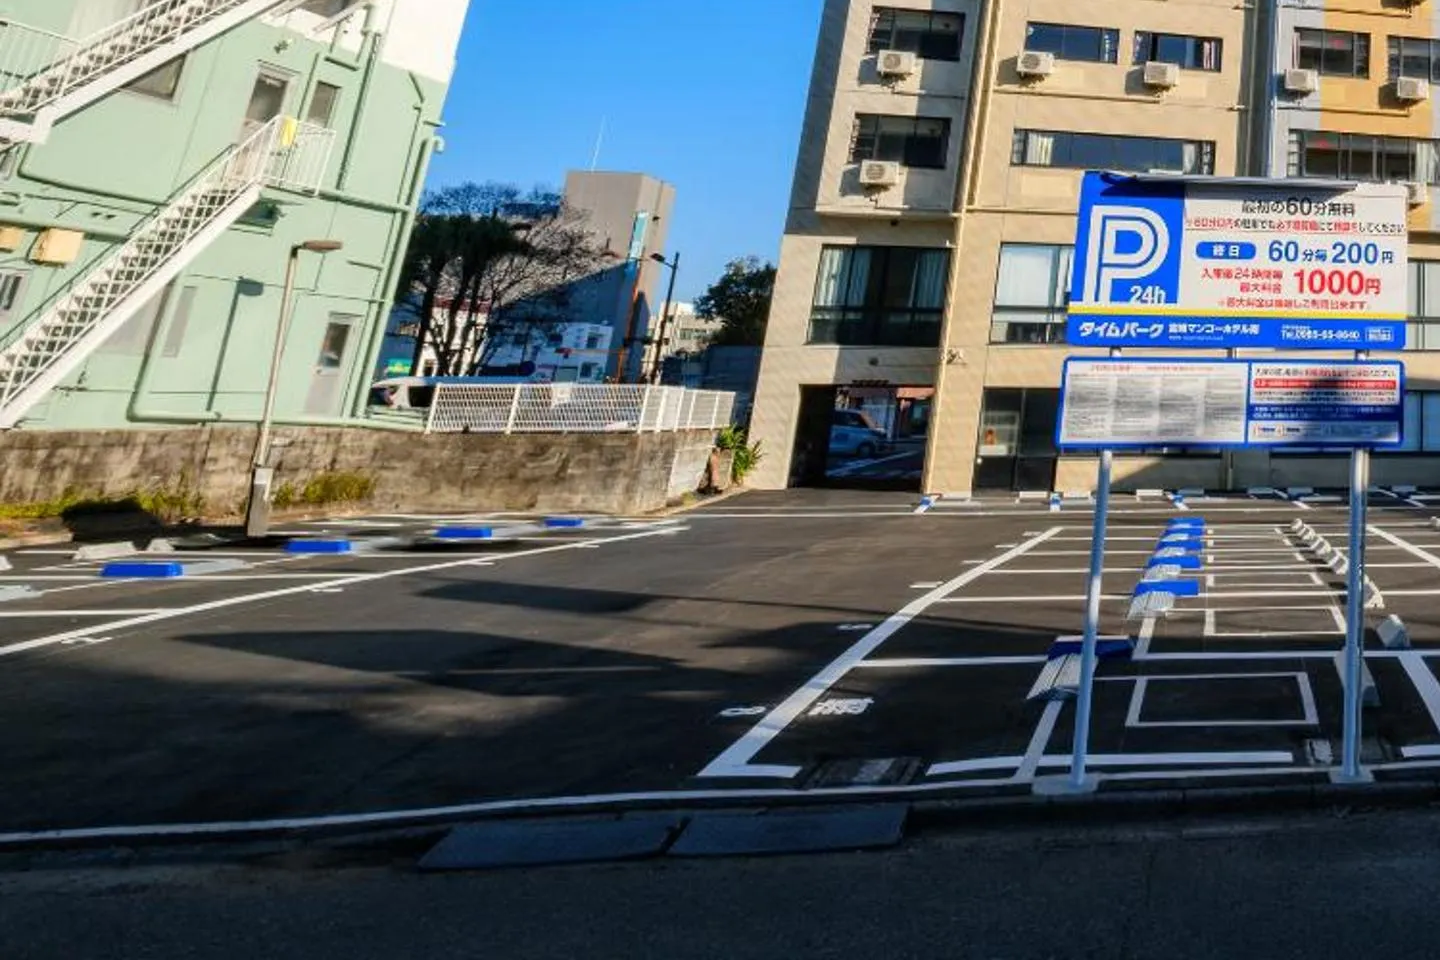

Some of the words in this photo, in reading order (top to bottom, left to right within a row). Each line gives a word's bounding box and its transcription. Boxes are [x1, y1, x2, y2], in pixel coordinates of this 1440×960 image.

[1082, 205, 1170, 304] P
[1293, 269, 1382, 296] 1000円
[1129, 285, 1167, 304] 24h
[1079, 322, 1164, 338] タイムパーク
